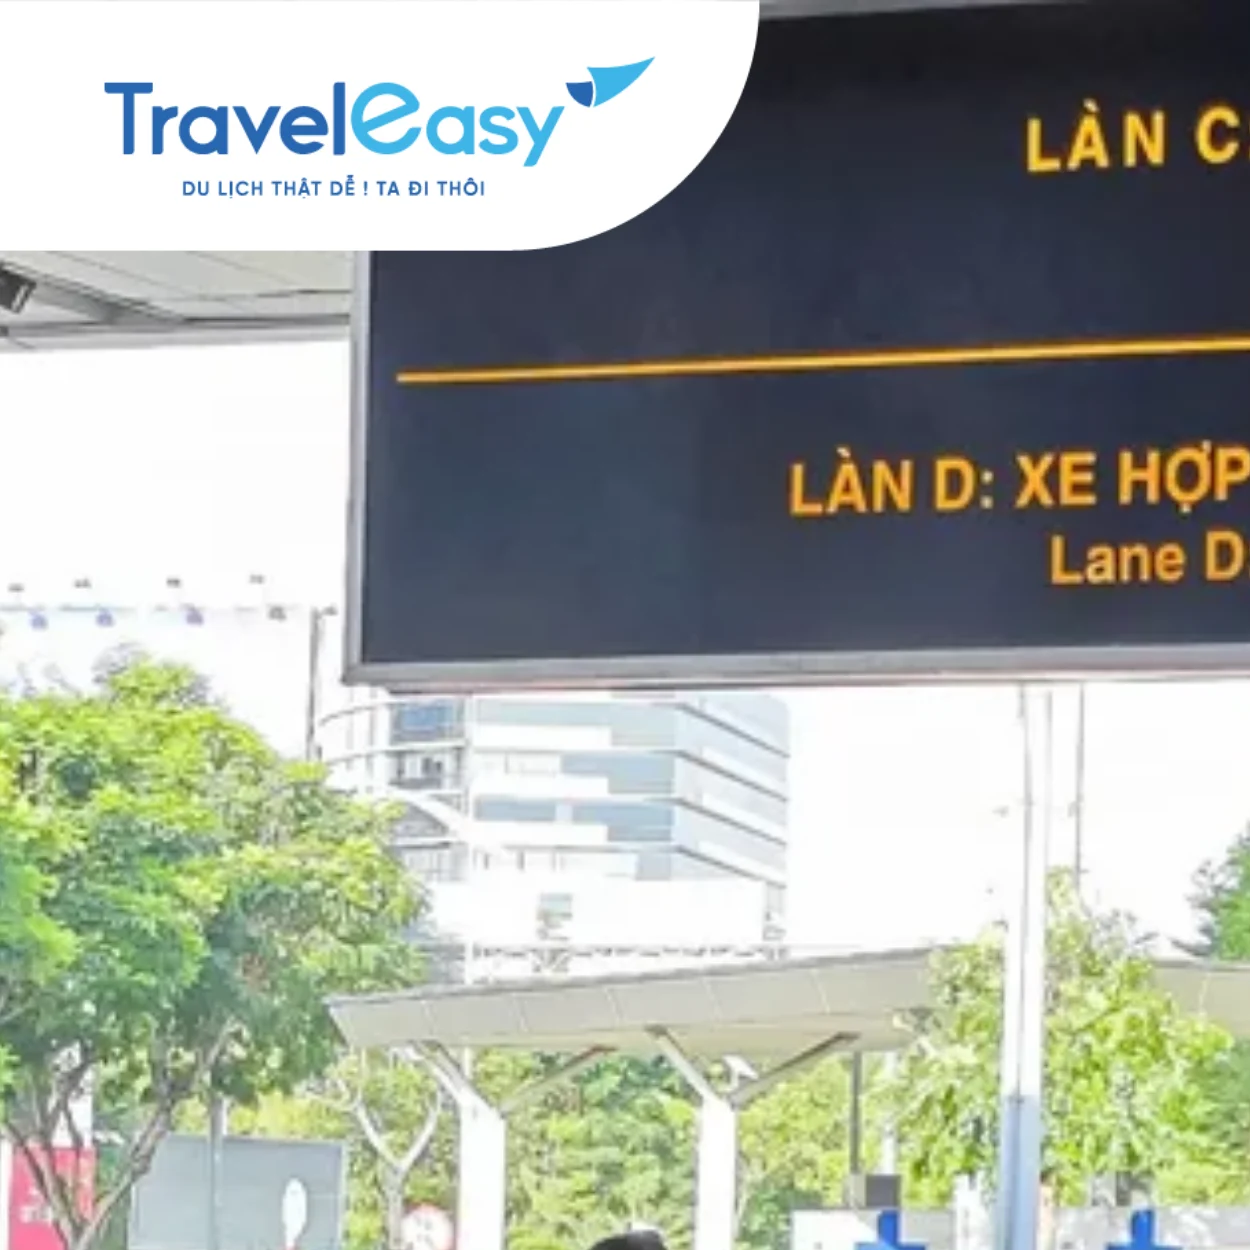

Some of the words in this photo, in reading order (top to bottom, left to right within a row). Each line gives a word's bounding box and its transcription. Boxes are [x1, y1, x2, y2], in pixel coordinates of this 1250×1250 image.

[1026, 102, 1166, 173] LÀN
[790, 447, 914, 517] LÀN
[934, 456, 995, 512] D:
[1015, 450, 1096, 508] XE
[1050, 532, 1186, 585] Lane
